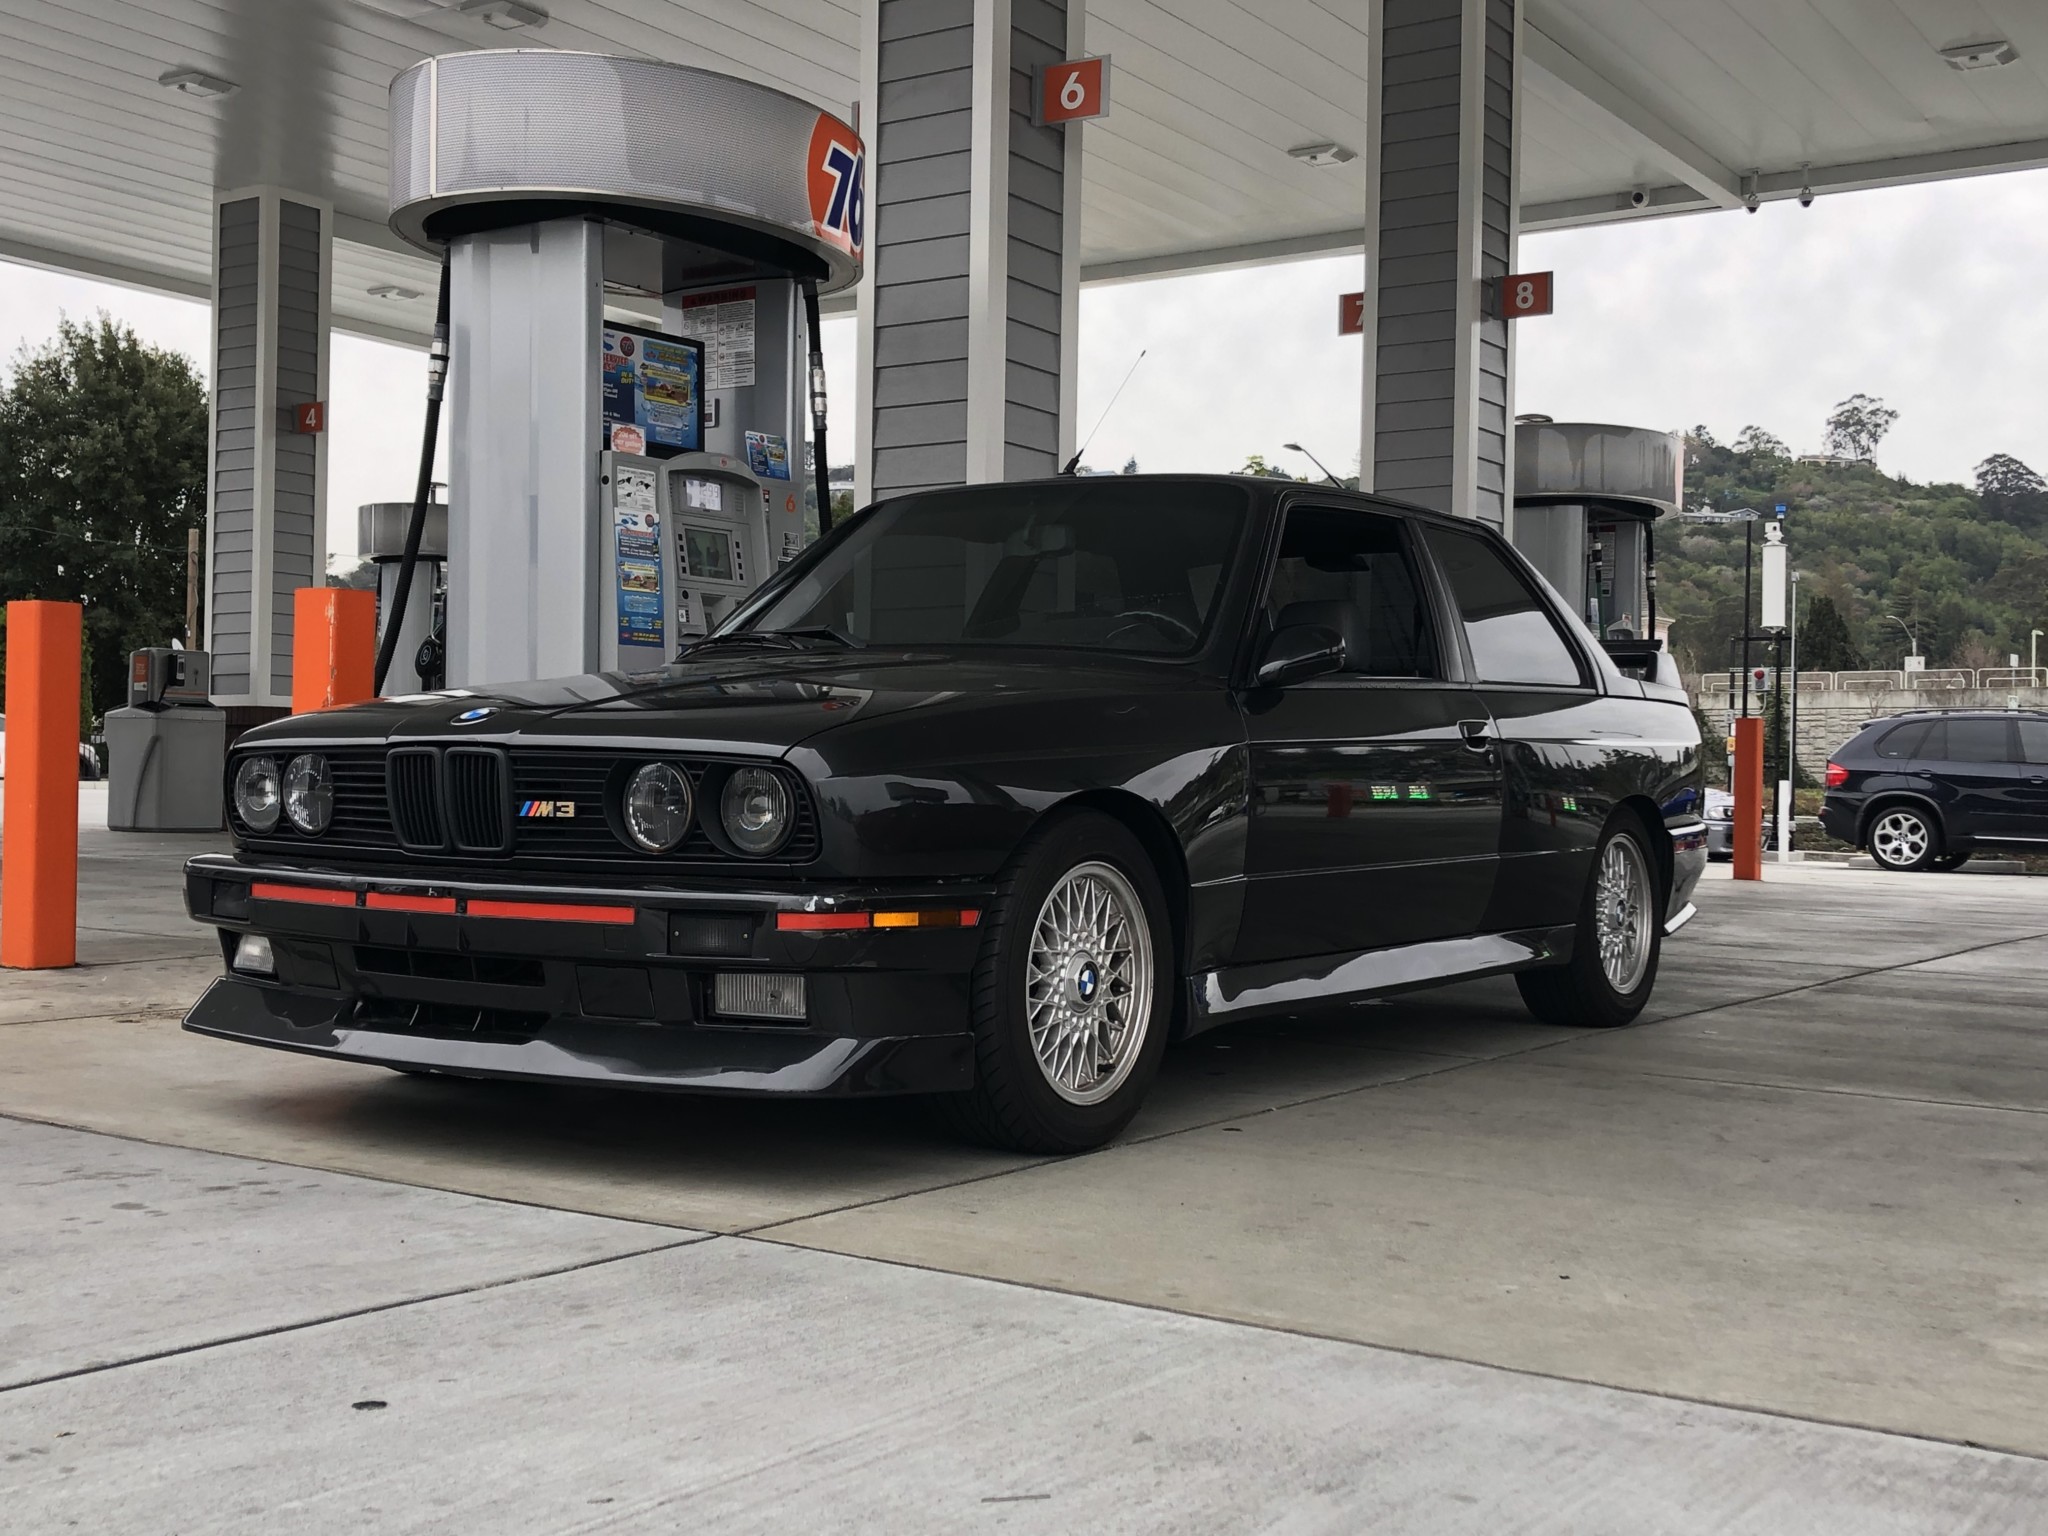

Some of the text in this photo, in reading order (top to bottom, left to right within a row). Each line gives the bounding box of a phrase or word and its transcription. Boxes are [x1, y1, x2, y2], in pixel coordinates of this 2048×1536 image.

[1060, 71, 1085, 110] 6
[822, 139, 865, 253] 76
[1515, 281, 1534, 309] 8
[305, 408, 316, 427] 4
[785, 494, 796, 513] 6
[534, 801, 575, 817] M3
